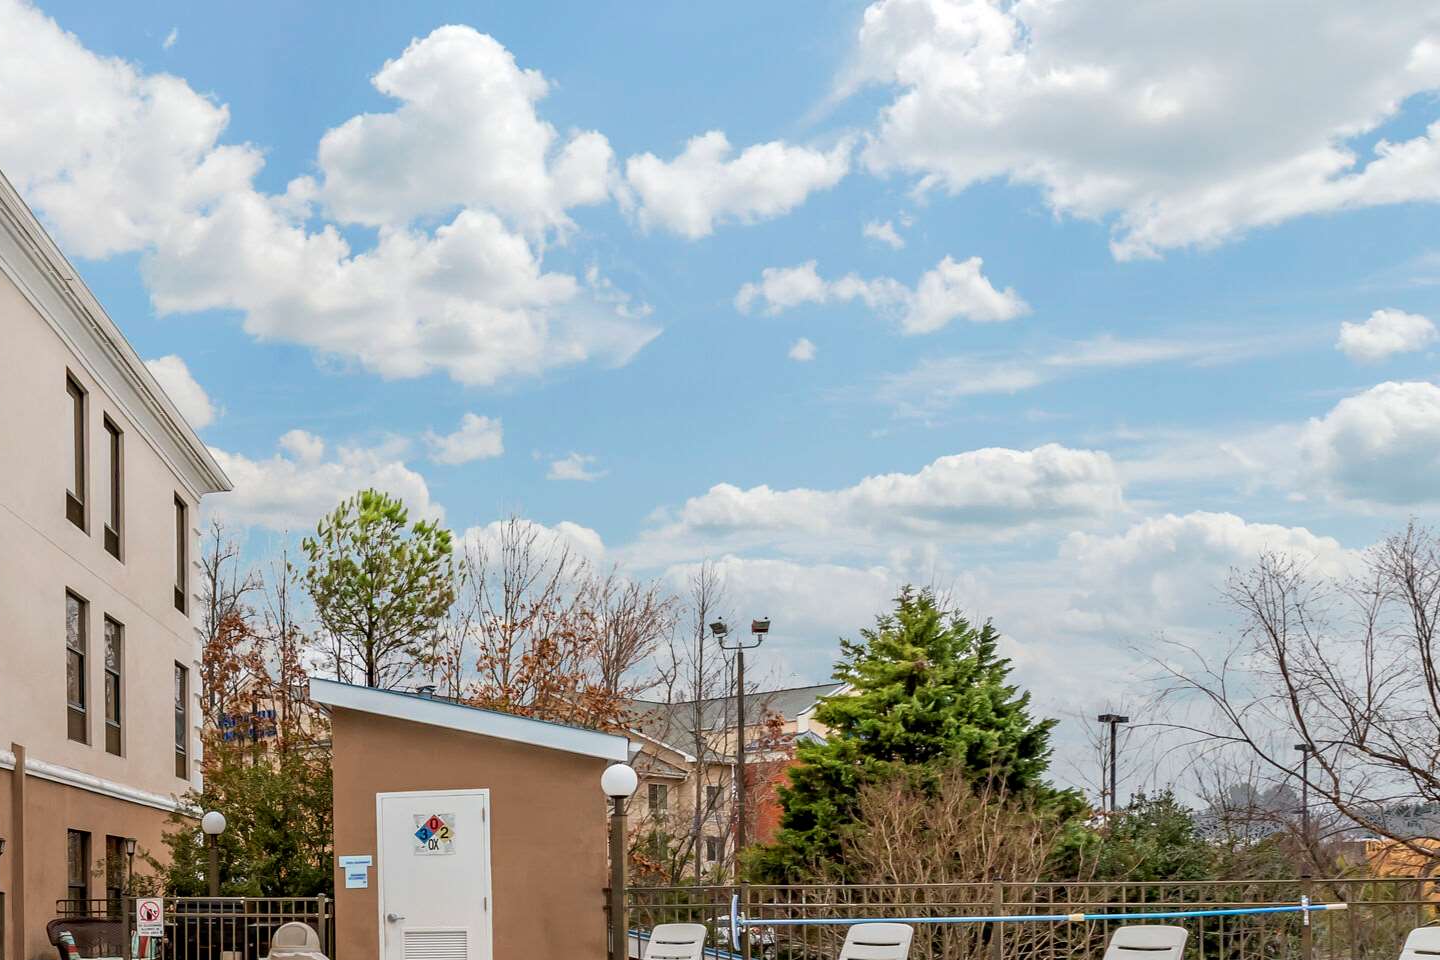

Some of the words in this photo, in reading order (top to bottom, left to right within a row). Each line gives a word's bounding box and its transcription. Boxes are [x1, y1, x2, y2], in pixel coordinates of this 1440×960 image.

[430, 818, 438, 829] 0
[420, 828, 428, 840] 3
[440, 827, 448, 838] 2
